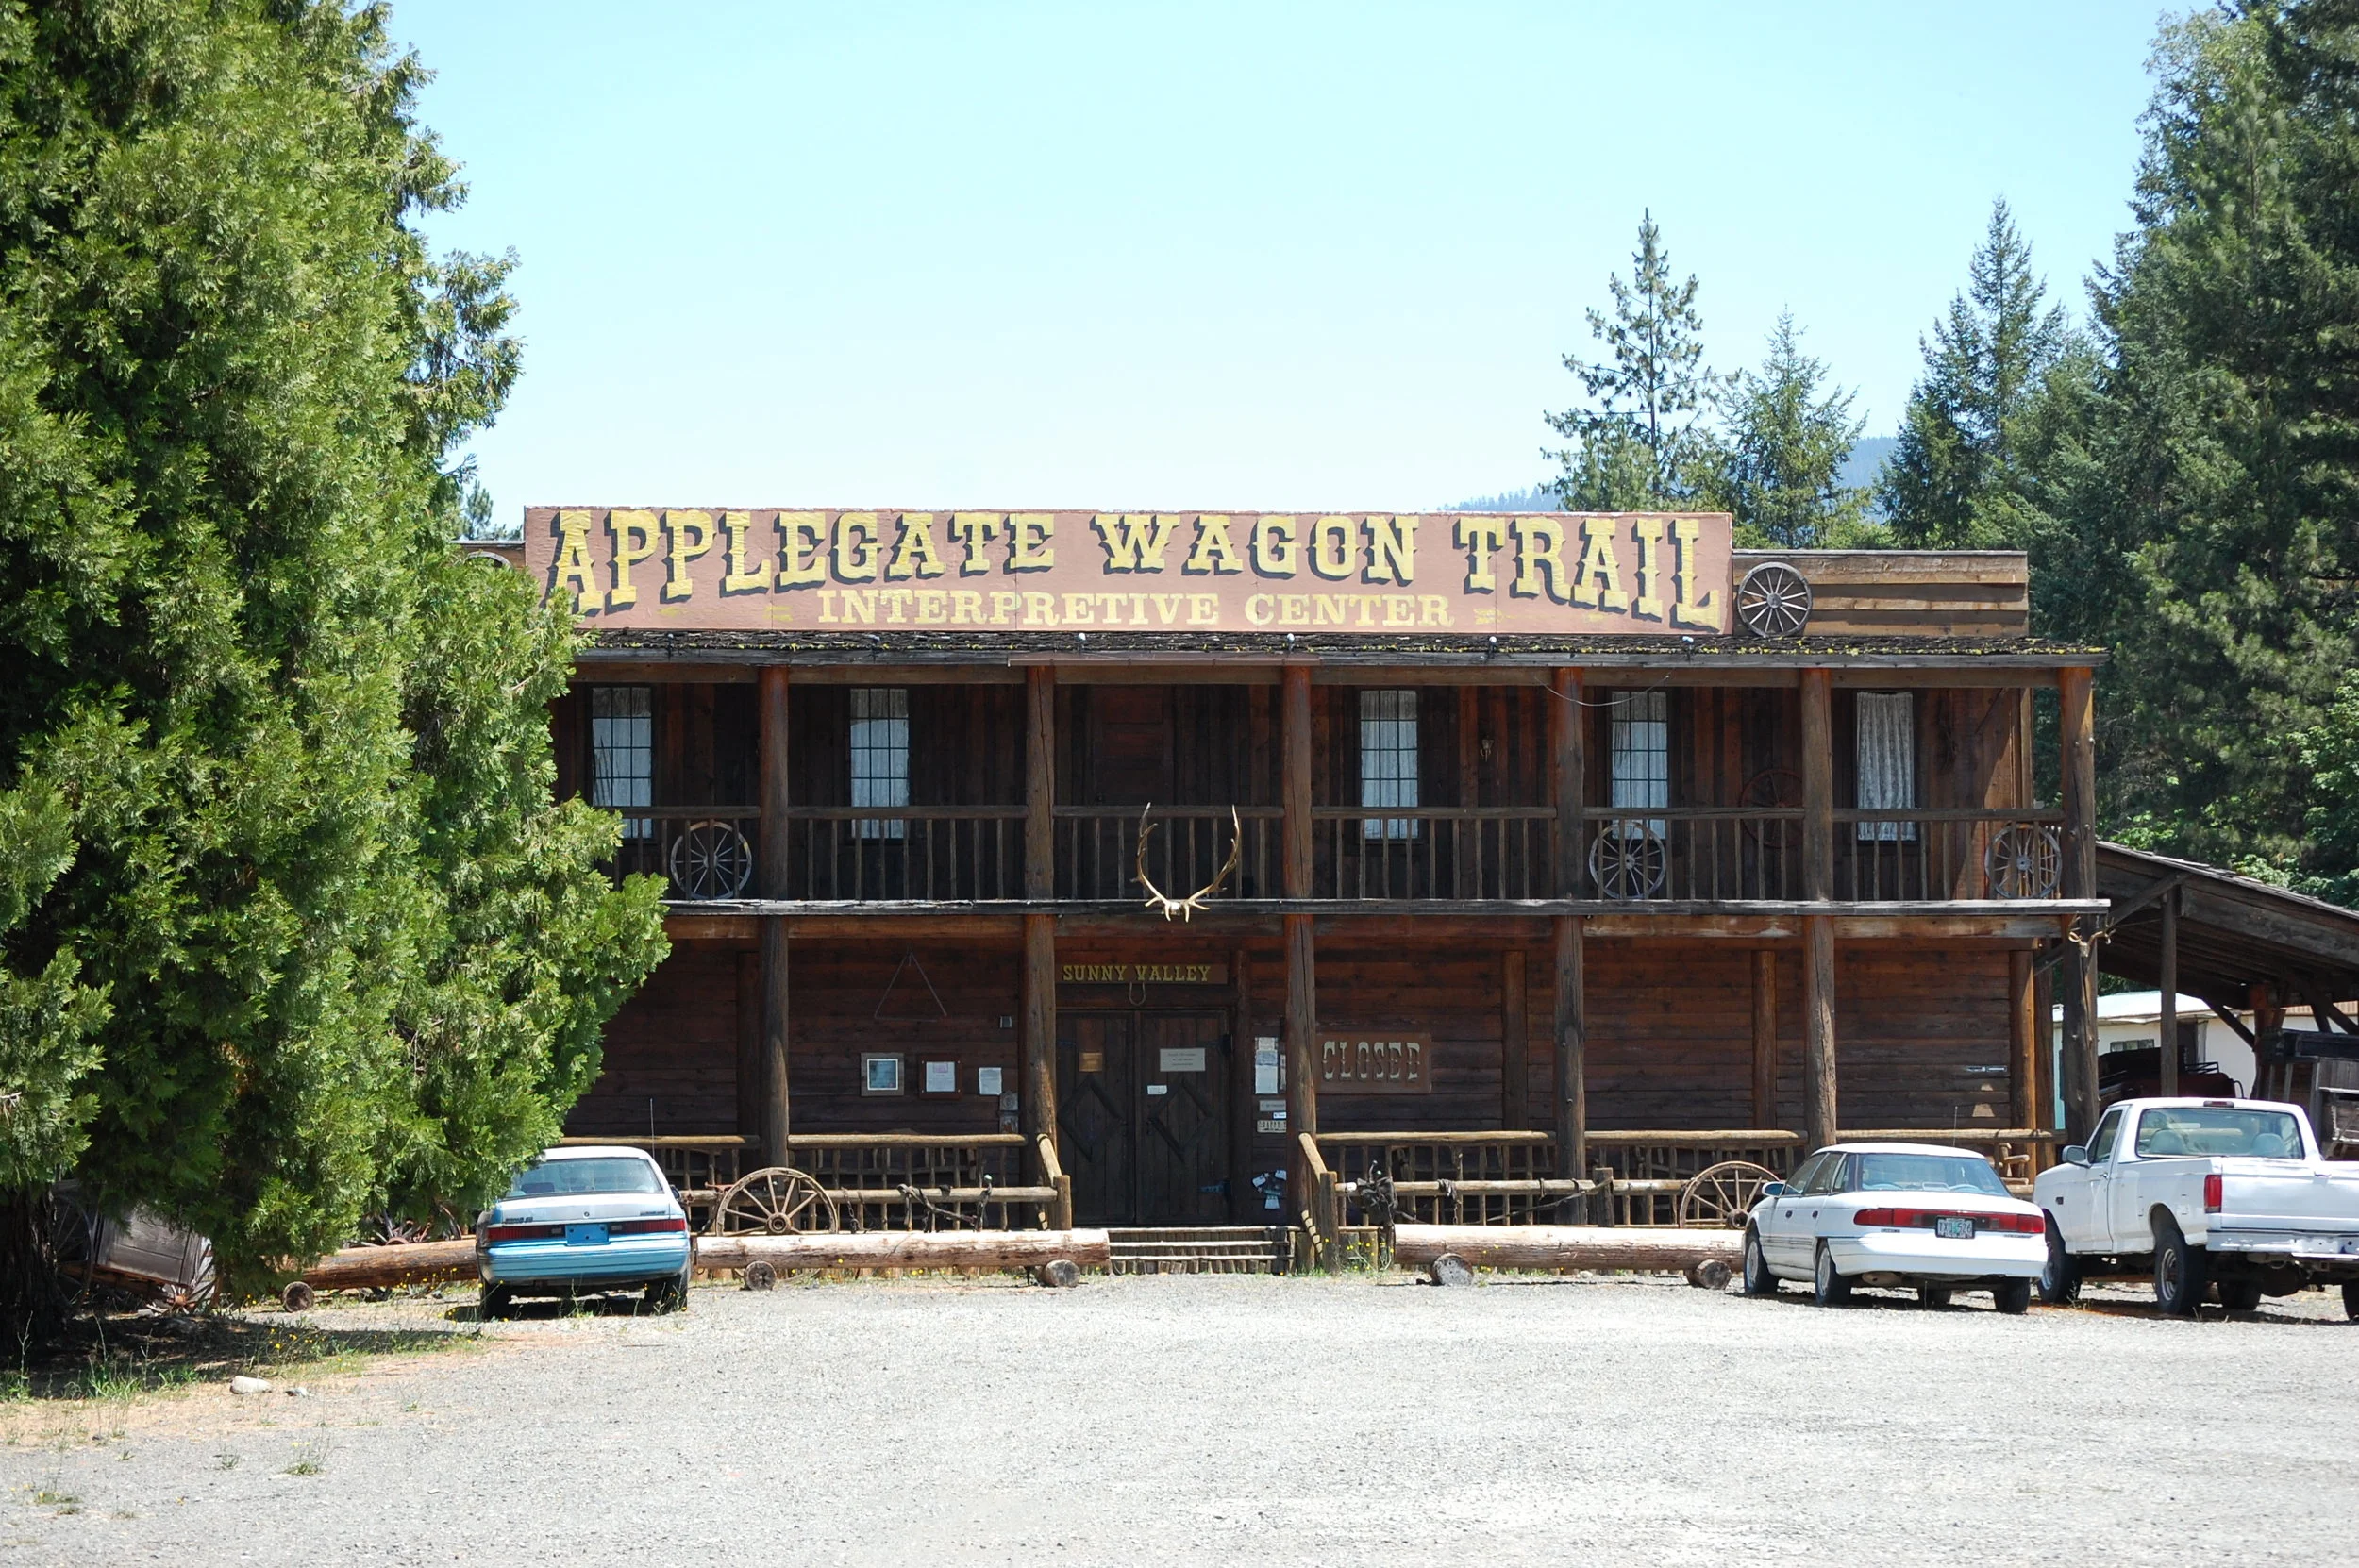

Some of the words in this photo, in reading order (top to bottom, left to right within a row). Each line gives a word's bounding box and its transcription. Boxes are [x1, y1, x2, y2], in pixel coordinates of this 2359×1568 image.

[540, 509, 1054, 616] APPLEGATE
[1091, 513, 1421, 586] WAGON
[1453, 515, 1721, 633] TRAIL
[817, 589, 1219, 626] INTERPRETIVE
[1245, 592, 1455, 626] CENTER
[1062, 964, 1128, 982] SUNNY
[1135, 964, 1212, 982] VALLEY
[1322, 1041, 1421, 1080] CLOSED
